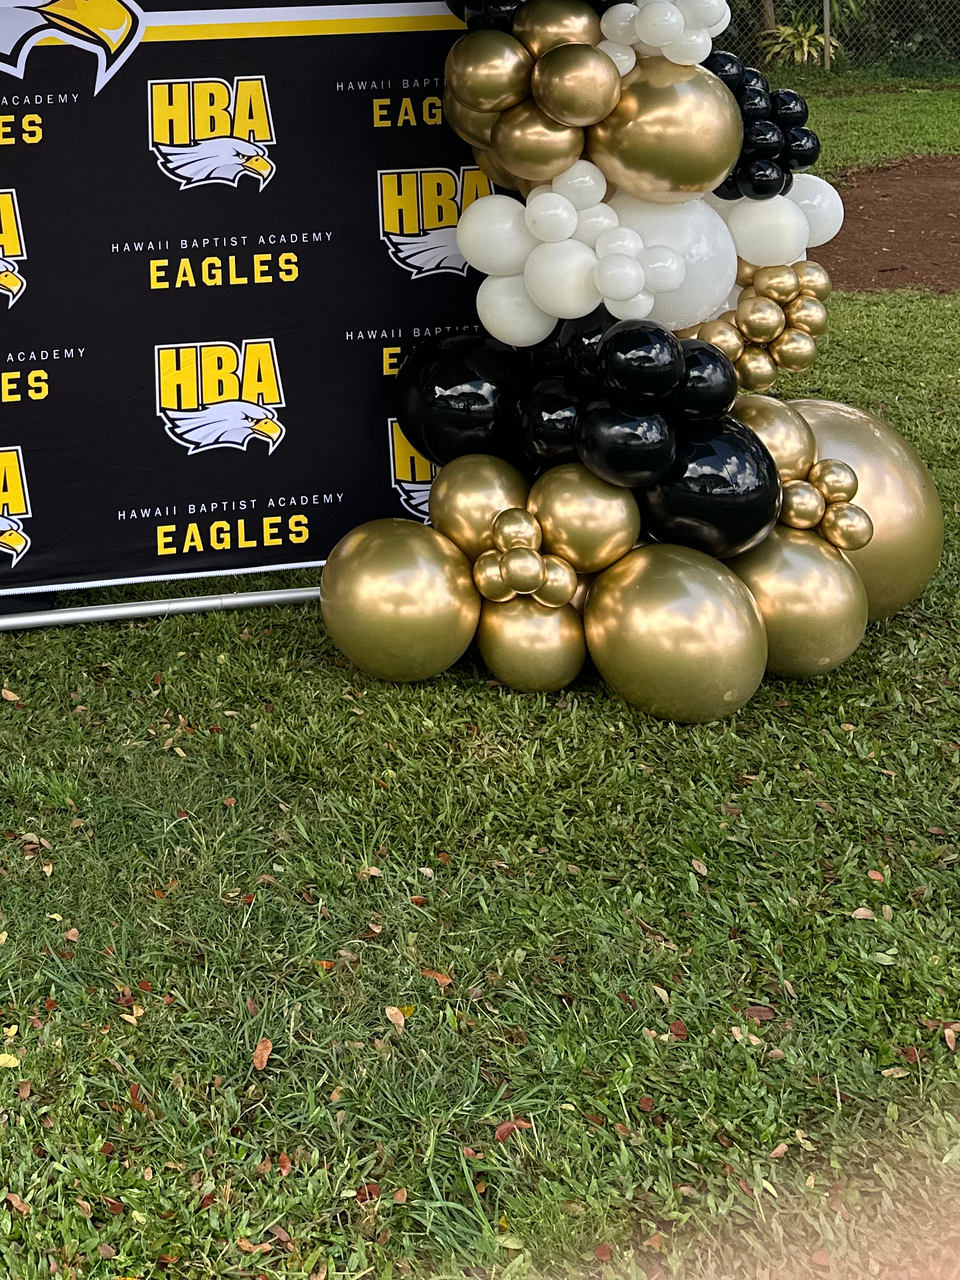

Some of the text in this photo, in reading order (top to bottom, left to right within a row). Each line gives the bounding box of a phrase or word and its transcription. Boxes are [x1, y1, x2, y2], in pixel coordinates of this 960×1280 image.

[1, 93, 79, 106] ACADEMY
[336, 78, 446, 92] HAWAII BAPTI
[149, 77, 274, 146] HBA
[373, 97, 442, 127] EAG
[111, 231, 332, 253] HAWAII BAPTIST ACADEMY
[149, 252, 299, 289] EAGLES
[345, 329, 402, 341] HAWAII
[6, 347, 85, 363] ACADEMY
[157, 340, 283, 411] HBA
[118, 492, 344, 521] HAWAII BAPTIST ACADEMY
[156, 514, 309, 556] EAGLES
